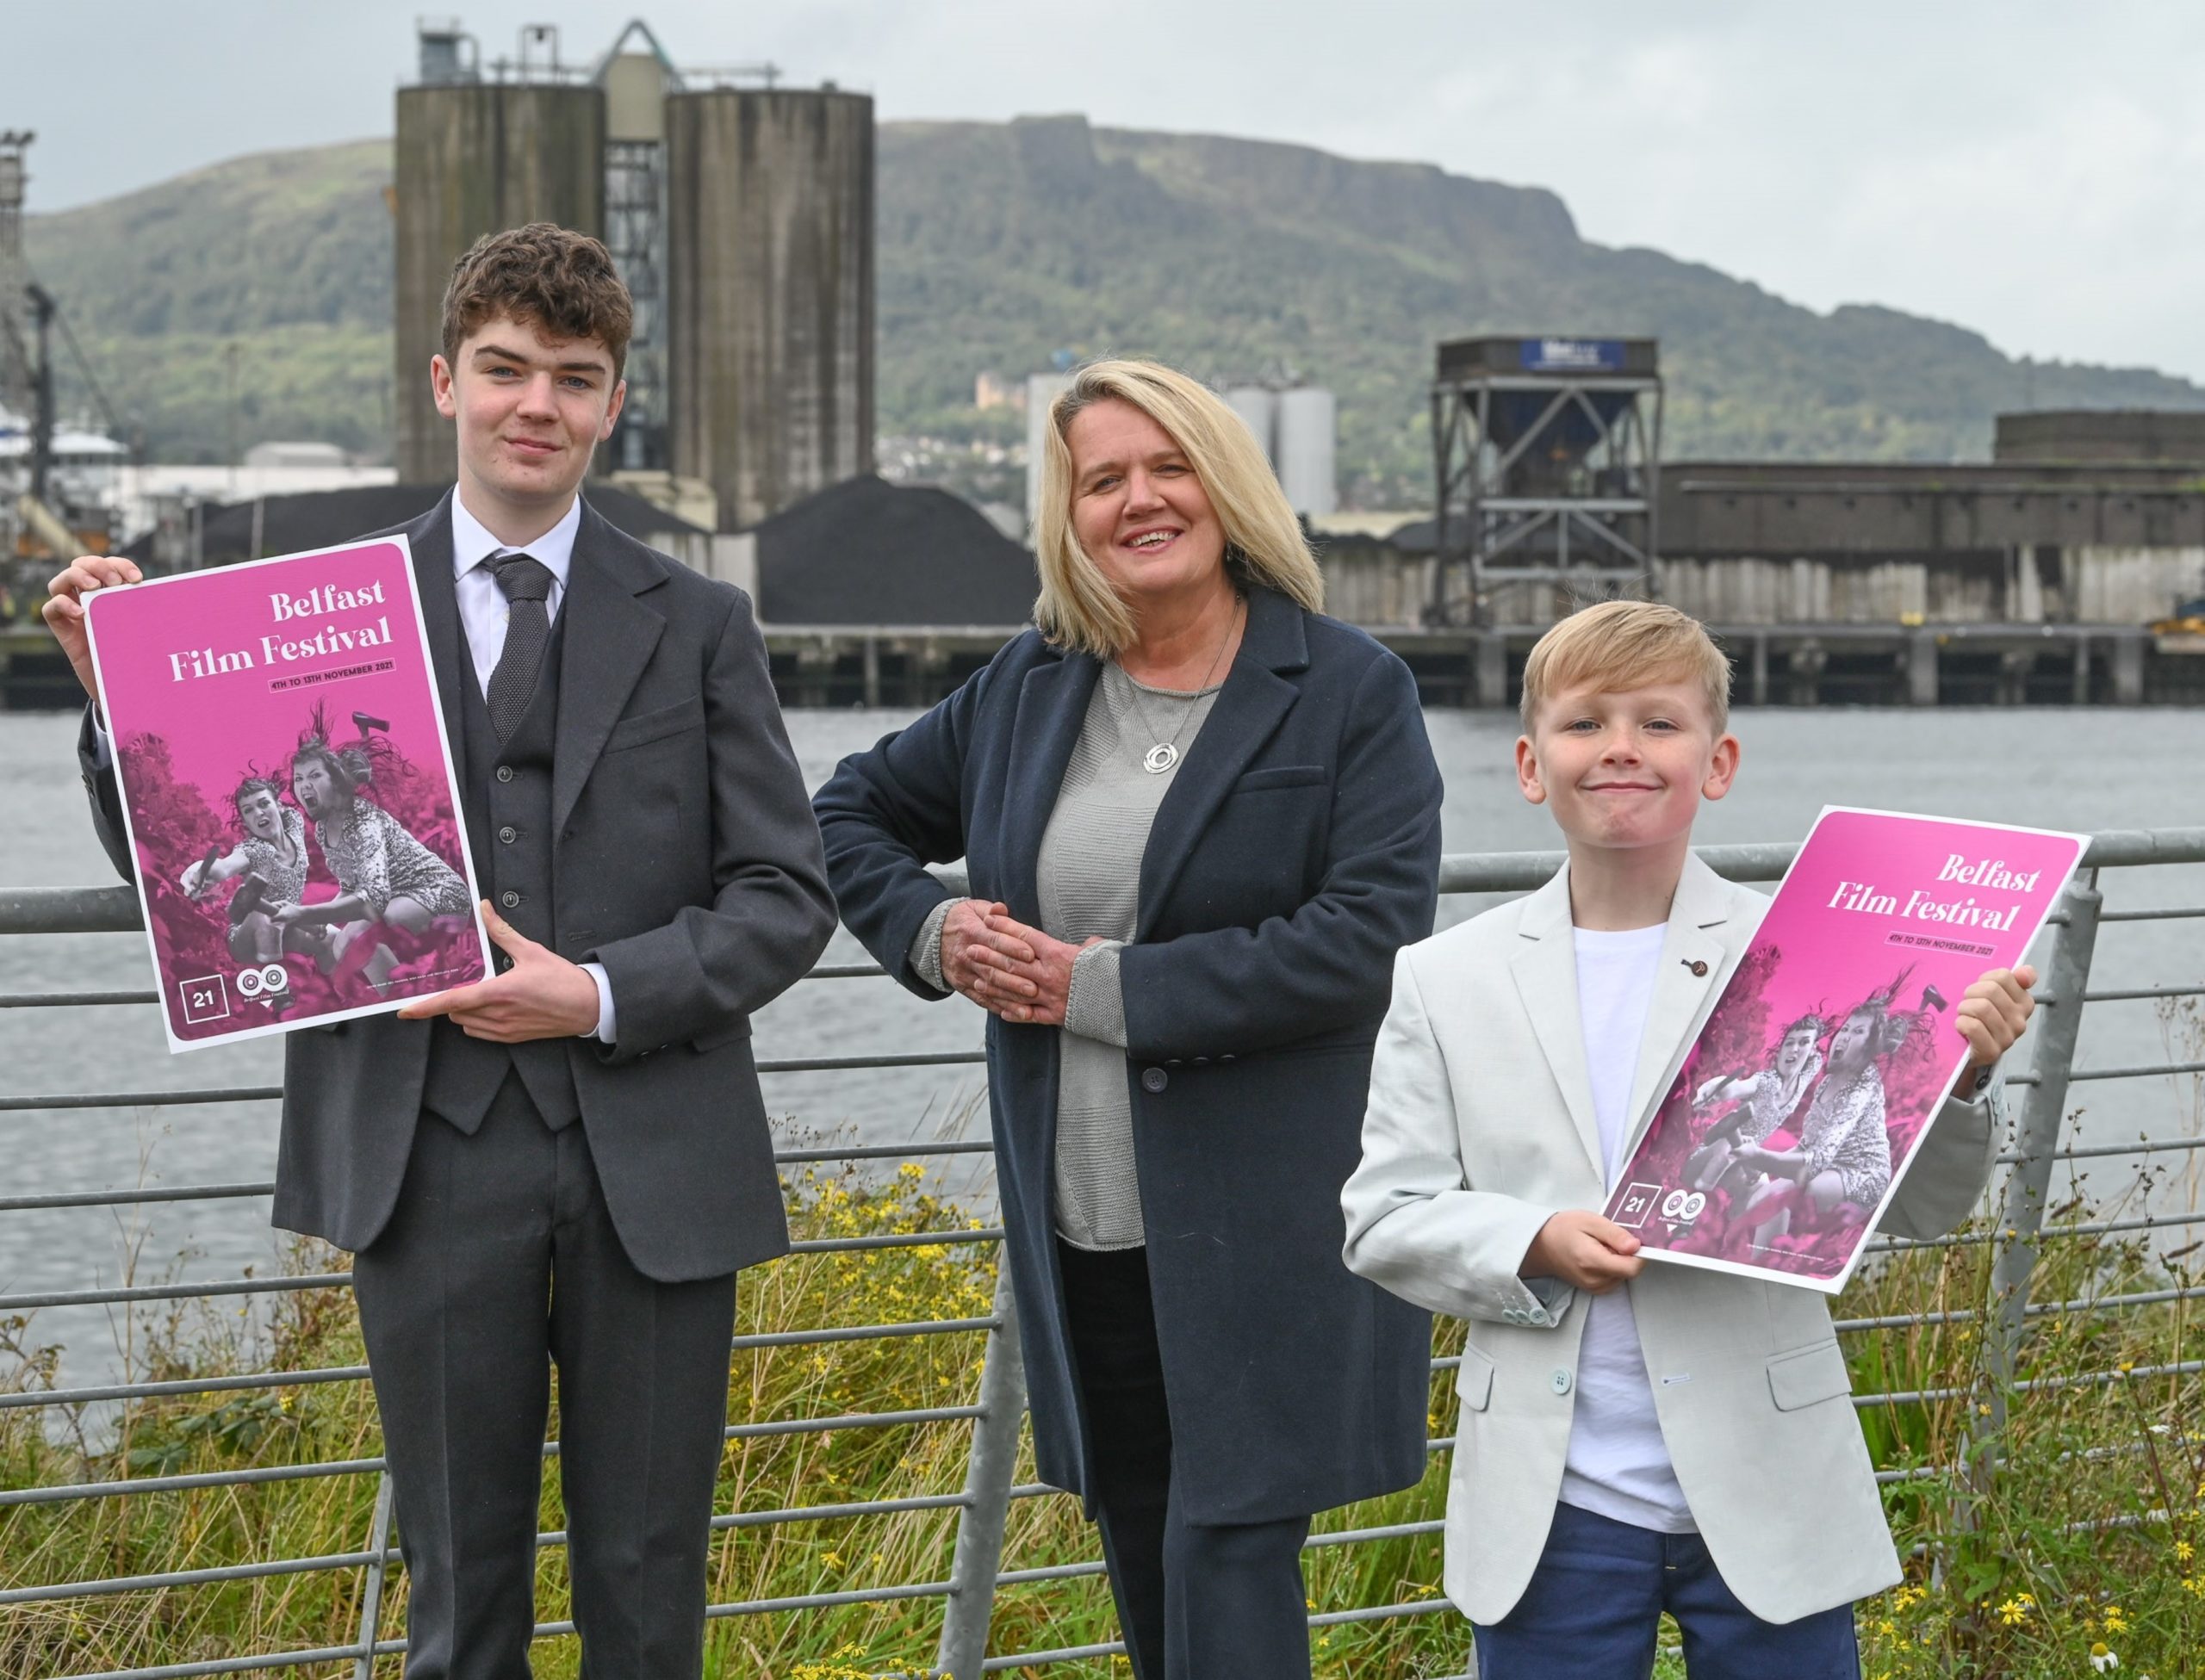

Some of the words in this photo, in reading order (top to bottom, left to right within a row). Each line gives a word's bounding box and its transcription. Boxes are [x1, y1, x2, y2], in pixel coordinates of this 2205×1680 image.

[268, 579, 387, 623] Belfast
[168, 647, 255, 682] Film
[258, 616, 394, 666] Festival
[271, 680, 287, 690] 4TH
[303, 674, 321, 684] 13TH
[325, 665, 373, 680] NOVEMBER
[376, 661, 394, 671] 2021
[1936, 853, 2042, 893] Belfast
[1827, 881, 1898, 915] Film
[1900, 890, 2022, 932] Festival
[1933, 940, 1975, 952] NOVEMBER
[193, 989, 214, 1007] 21
[1624, 1197, 1646, 1212] 21
